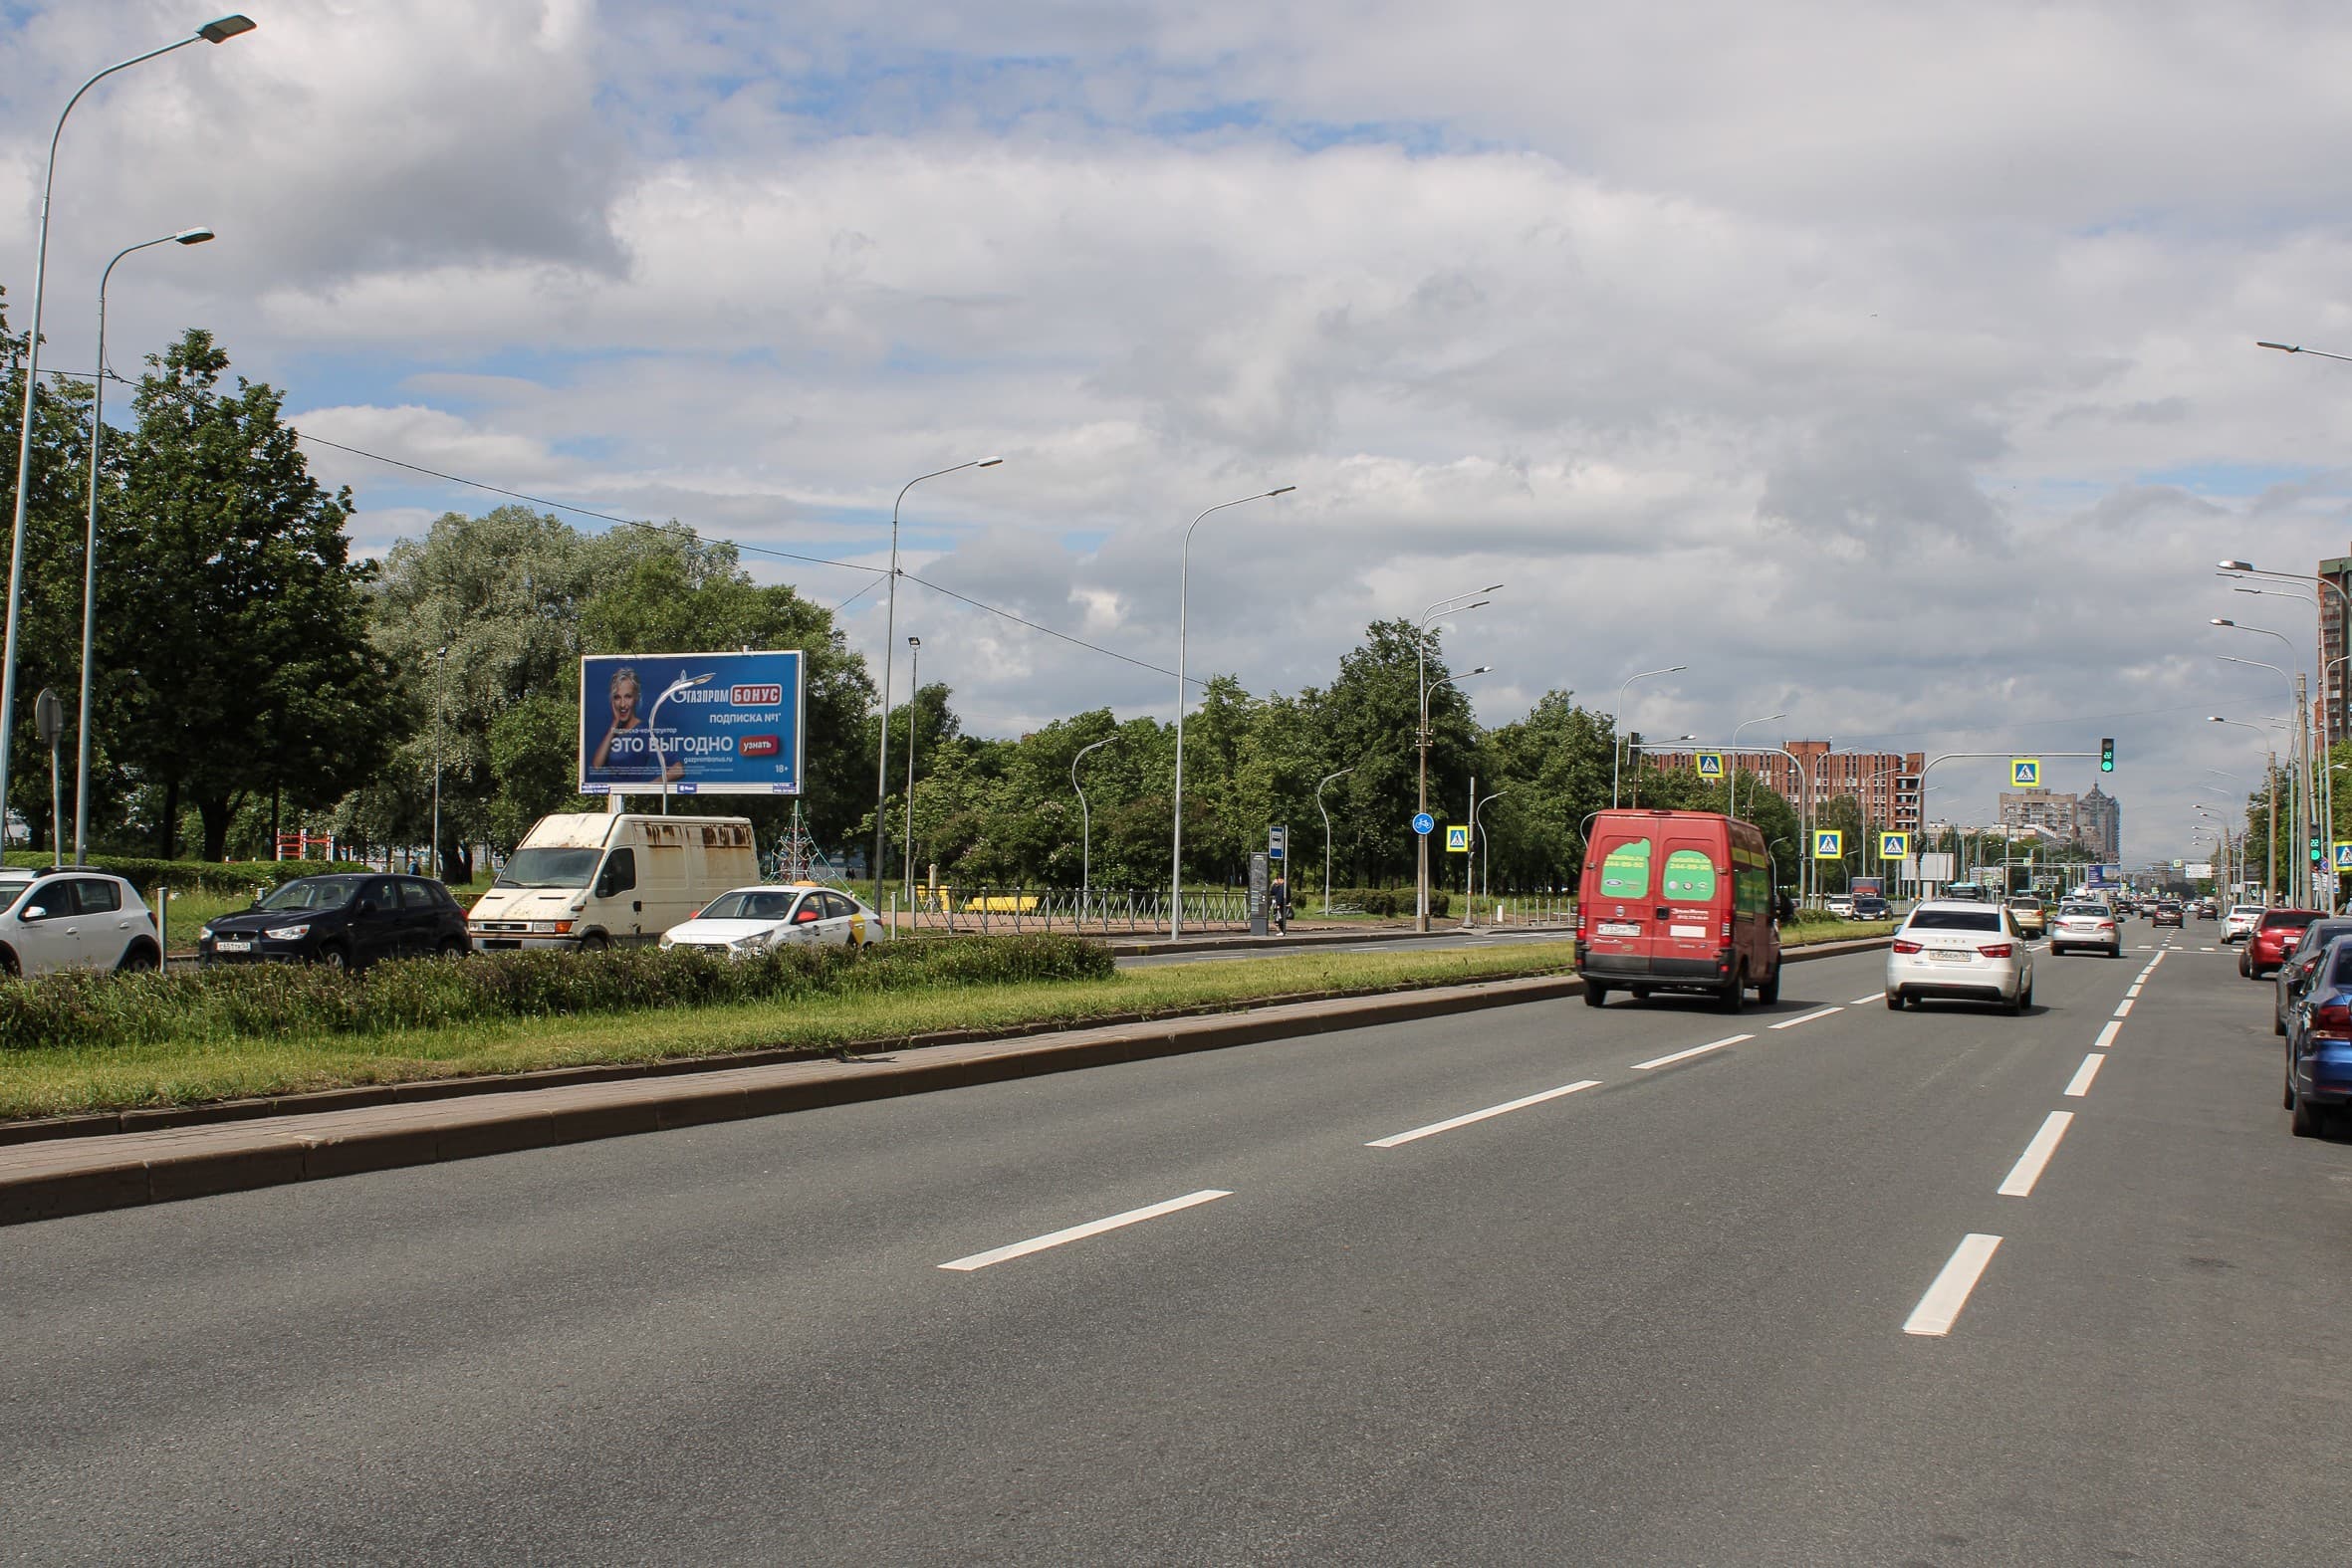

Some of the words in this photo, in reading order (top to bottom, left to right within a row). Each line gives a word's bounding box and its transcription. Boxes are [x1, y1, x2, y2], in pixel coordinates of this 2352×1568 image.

[734, 689, 778, 702] БОНУС
[709, 714, 762, 725] ПОДПИСКА
[611, 737, 644, 753] ЭТО
[649, 736, 734, 756] ВЫГОДНО
[743, 741, 772, 752] узнать
[775, 764, 789, 773] 18+
